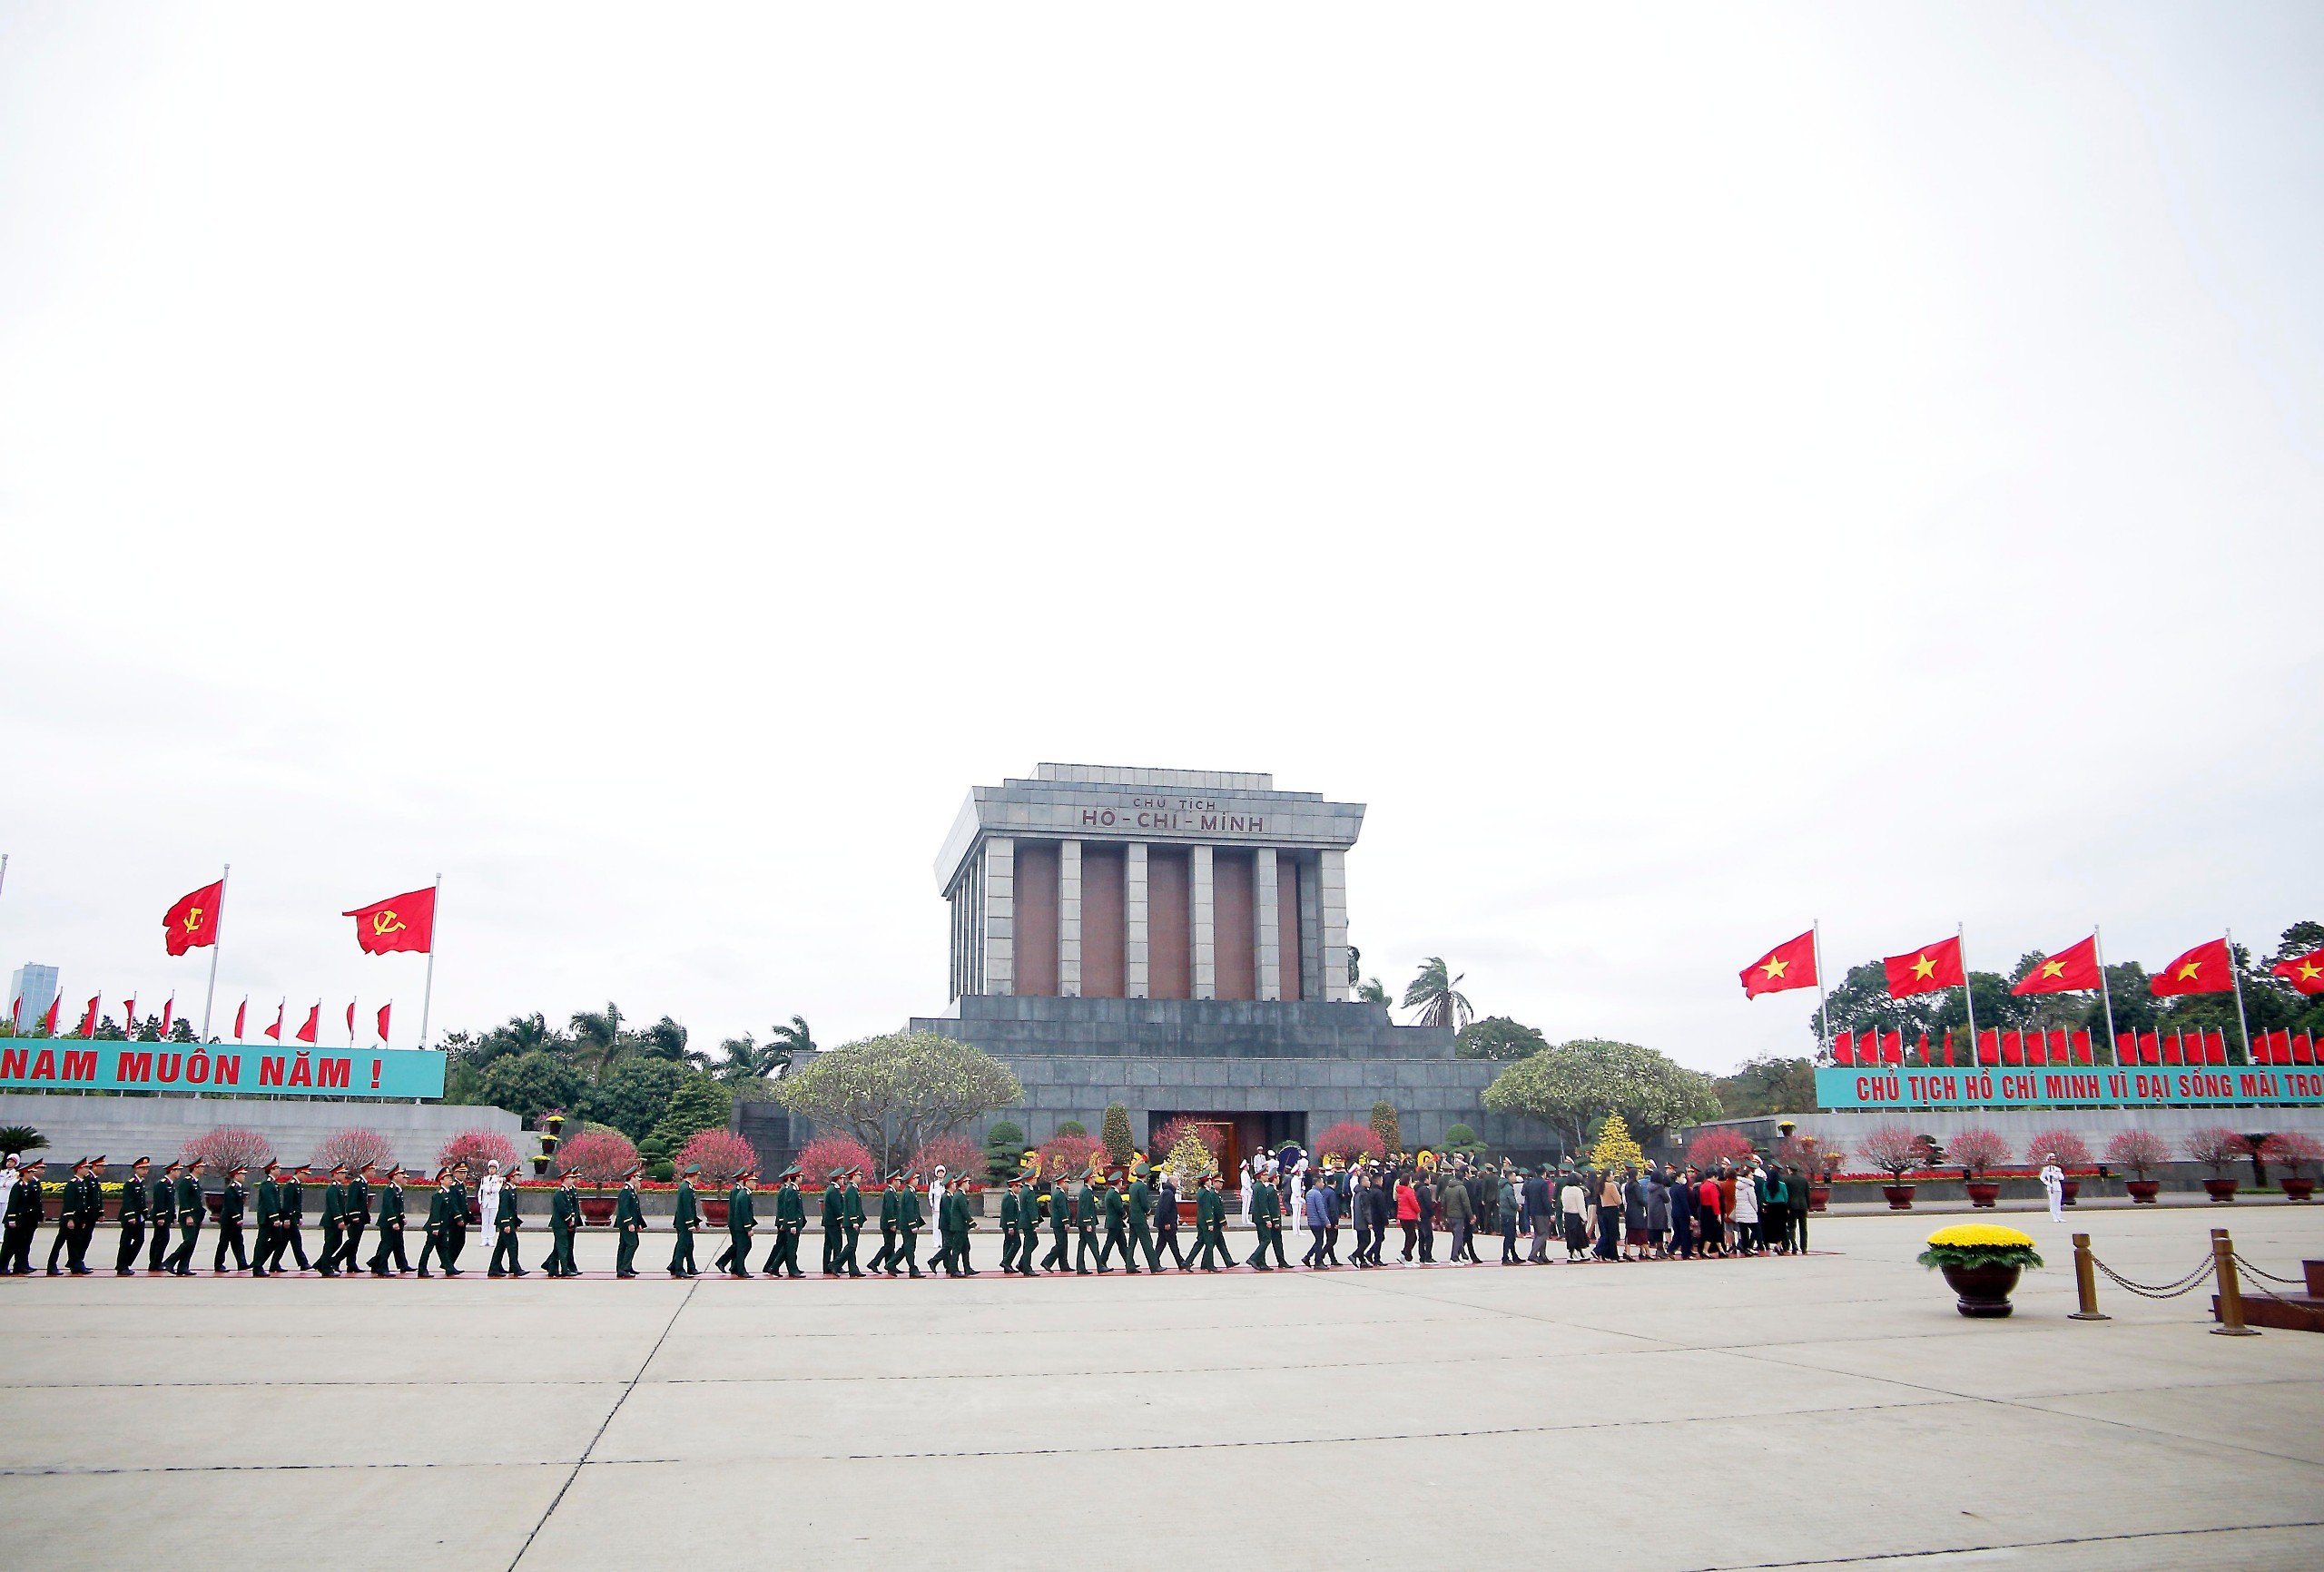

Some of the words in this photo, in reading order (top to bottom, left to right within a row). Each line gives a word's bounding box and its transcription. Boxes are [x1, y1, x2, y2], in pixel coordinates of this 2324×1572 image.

[0, 1048, 98, 1081] NAM
[116, 1047, 241, 1085] MUÔN
[259, 1050, 351, 1088] NĂM
[1856, 1068, 1900, 1101] CHỦ
[1907, 1076, 1957, 1105] TỊCH
[1965, 1067, 1994, 1099] HỒ
[2002, 1070, 2038, 1099] CHÍ
[2045, 1075, 2102, 1099] MINH
[2107, 1070, 2129, 1098] VĨ
[2135, 1075, 2171, 1103] ĐẠI
[2180, 1067, 2233, 1097] SỐNG
[2240, 1070, 2280, 1097] MÃI
[2284, 1074, 2324, 1096] TRO
